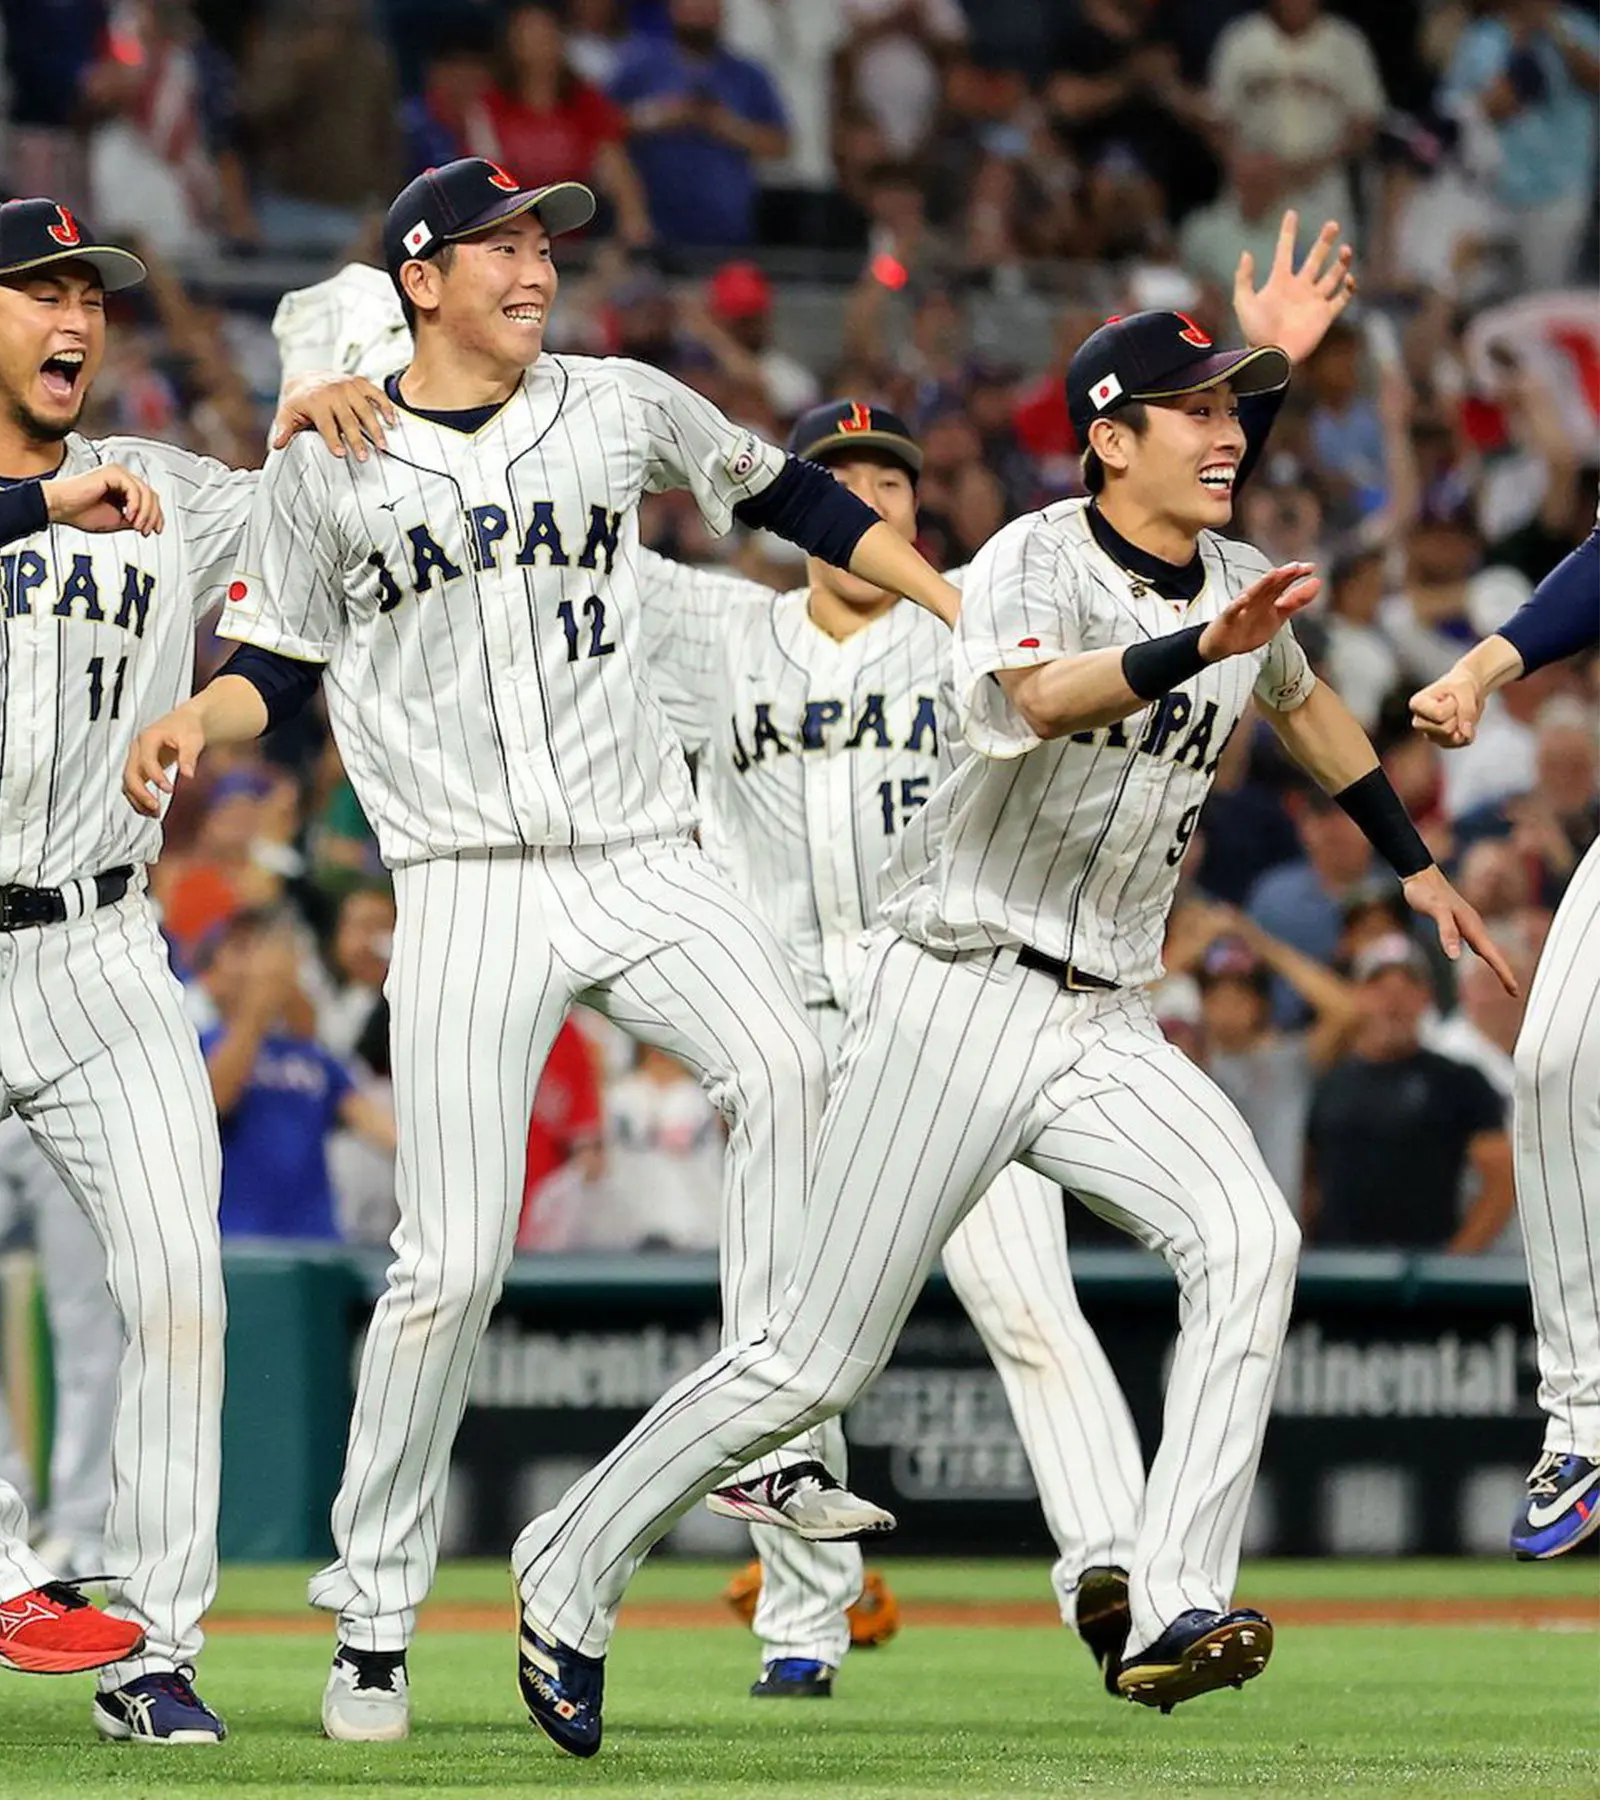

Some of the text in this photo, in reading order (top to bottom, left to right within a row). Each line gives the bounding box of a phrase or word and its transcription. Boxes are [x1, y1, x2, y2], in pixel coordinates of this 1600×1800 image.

[46, 204, 82, 247] J
[837, 402, 872, 434] J
[367, 501, 622, 613] JAPAN
[557, 594, 616, 662] 12
[86, 656, 128, 722] 11
[732, 694, 939, 774] JAPAN
[878, 776, 930, 836] 15
[1167, 804, 1200, 867] 9
